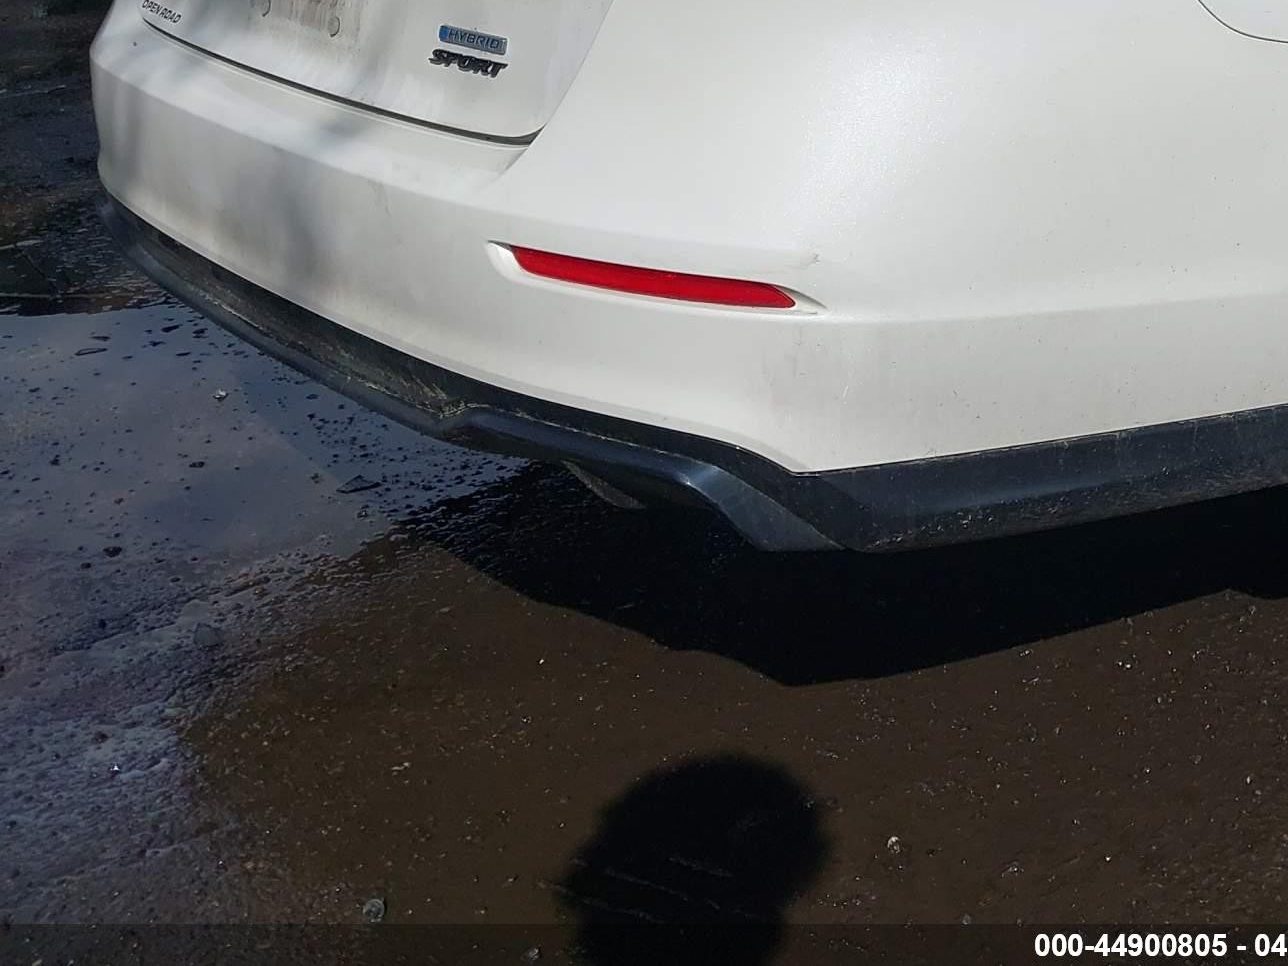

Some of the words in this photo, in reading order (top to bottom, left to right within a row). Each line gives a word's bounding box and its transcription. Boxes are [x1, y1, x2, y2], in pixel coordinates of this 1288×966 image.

[160, 7, 182, 24] ROAD
[447, 29, 500, 49] HYBRID
[428, 48, 508, 78] SPORT
